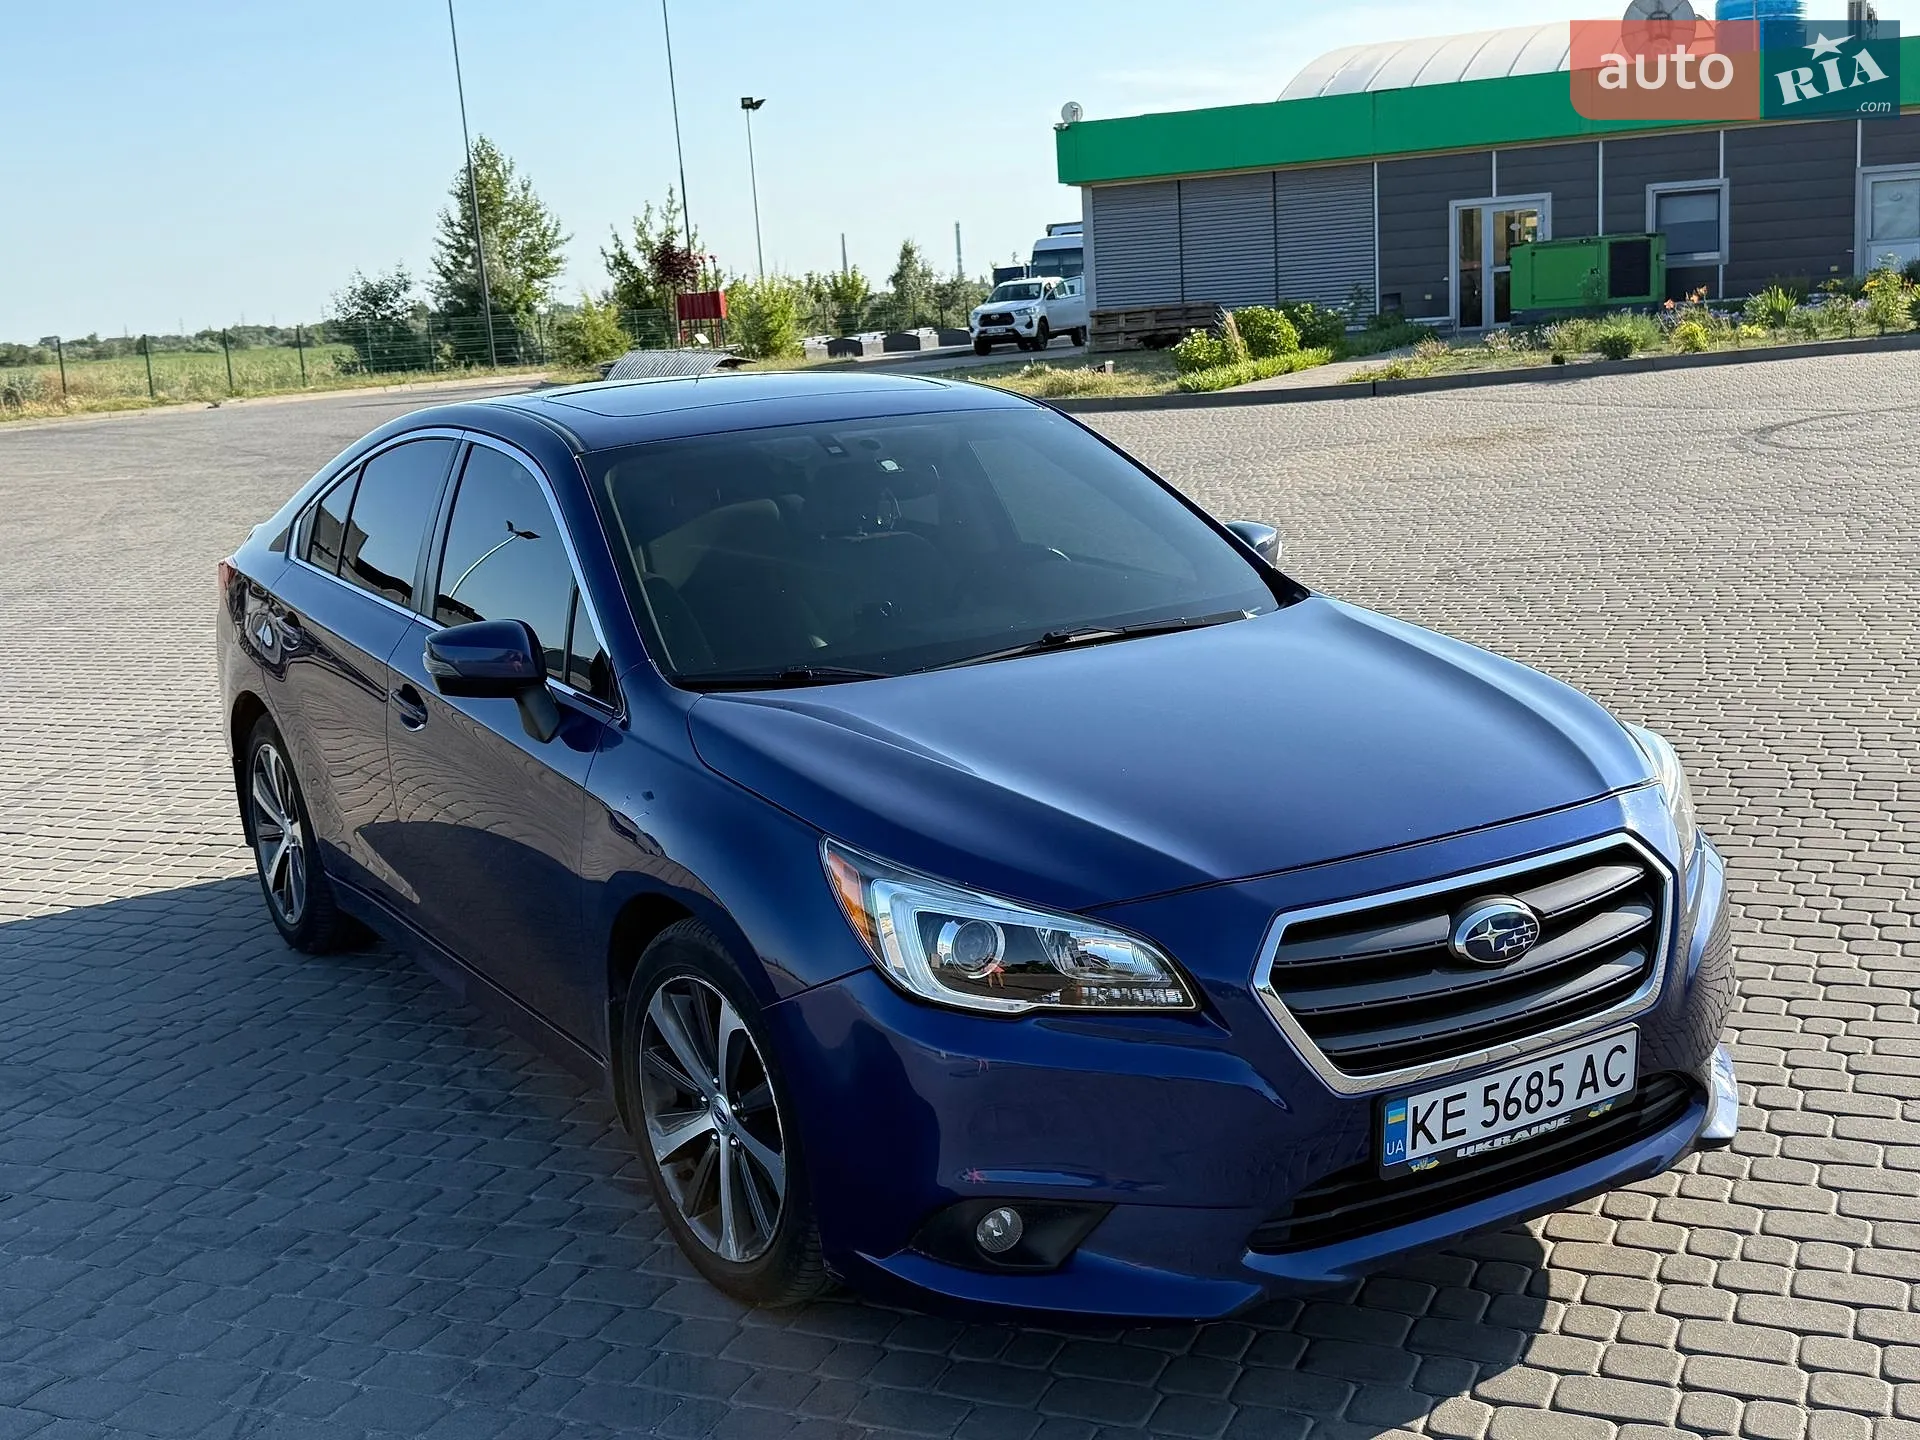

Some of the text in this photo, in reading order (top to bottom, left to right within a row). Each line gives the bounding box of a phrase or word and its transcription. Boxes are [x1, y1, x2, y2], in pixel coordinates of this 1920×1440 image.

[1410, 1044, 1628, 1150] KE 5685 AC
[1386, 1138, 1405, 1156] UA
[1456, 1114, 1573, 1158] UKRAINE
